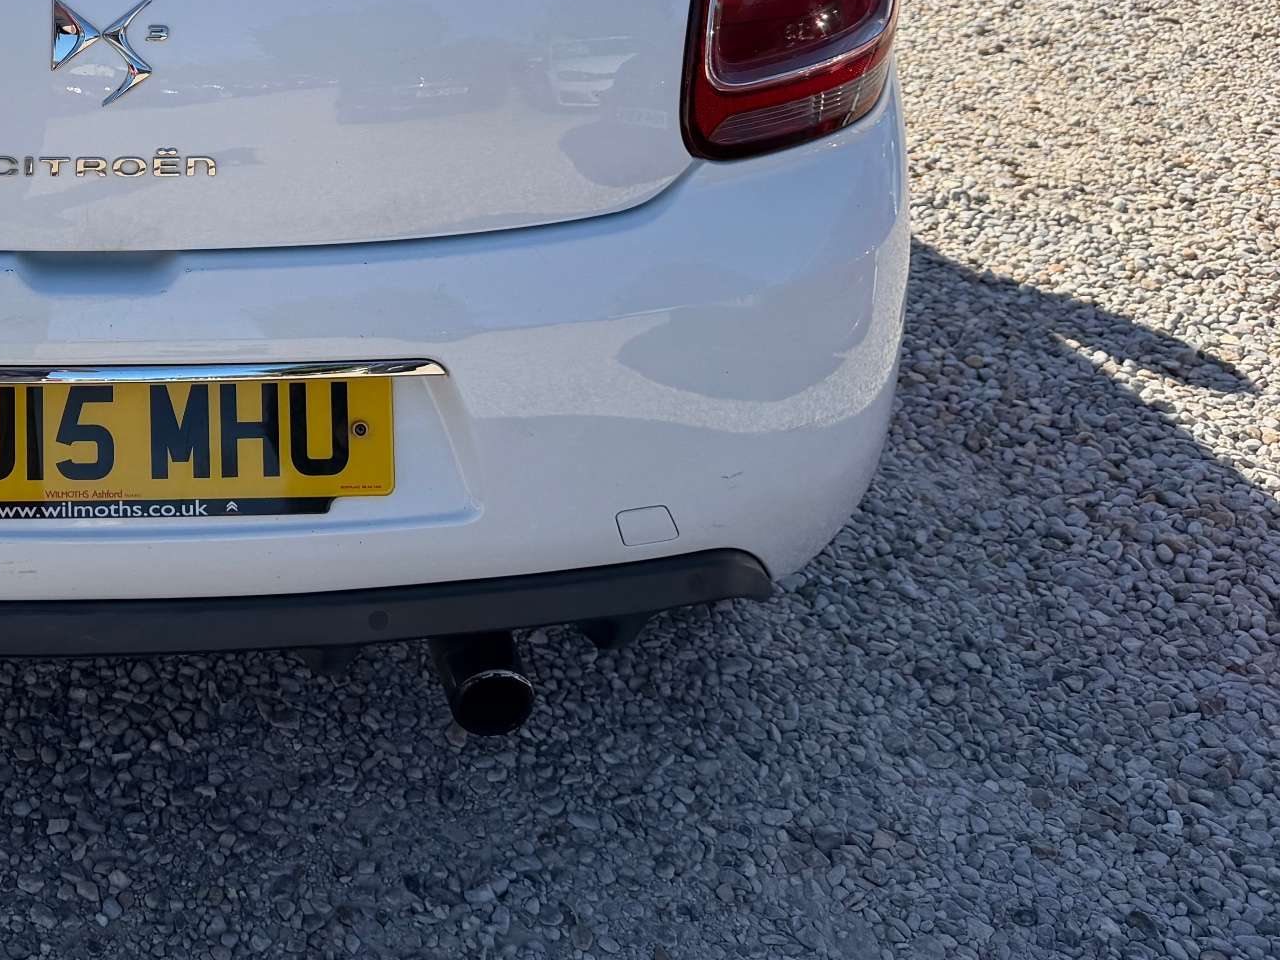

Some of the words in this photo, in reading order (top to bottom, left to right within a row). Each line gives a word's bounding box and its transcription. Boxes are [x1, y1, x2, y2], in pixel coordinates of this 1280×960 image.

[149, 381, 349, 480] MHU
[45, 489, 89, 499] WILMOTHS
[91, 489, 123, 499] Ashford
